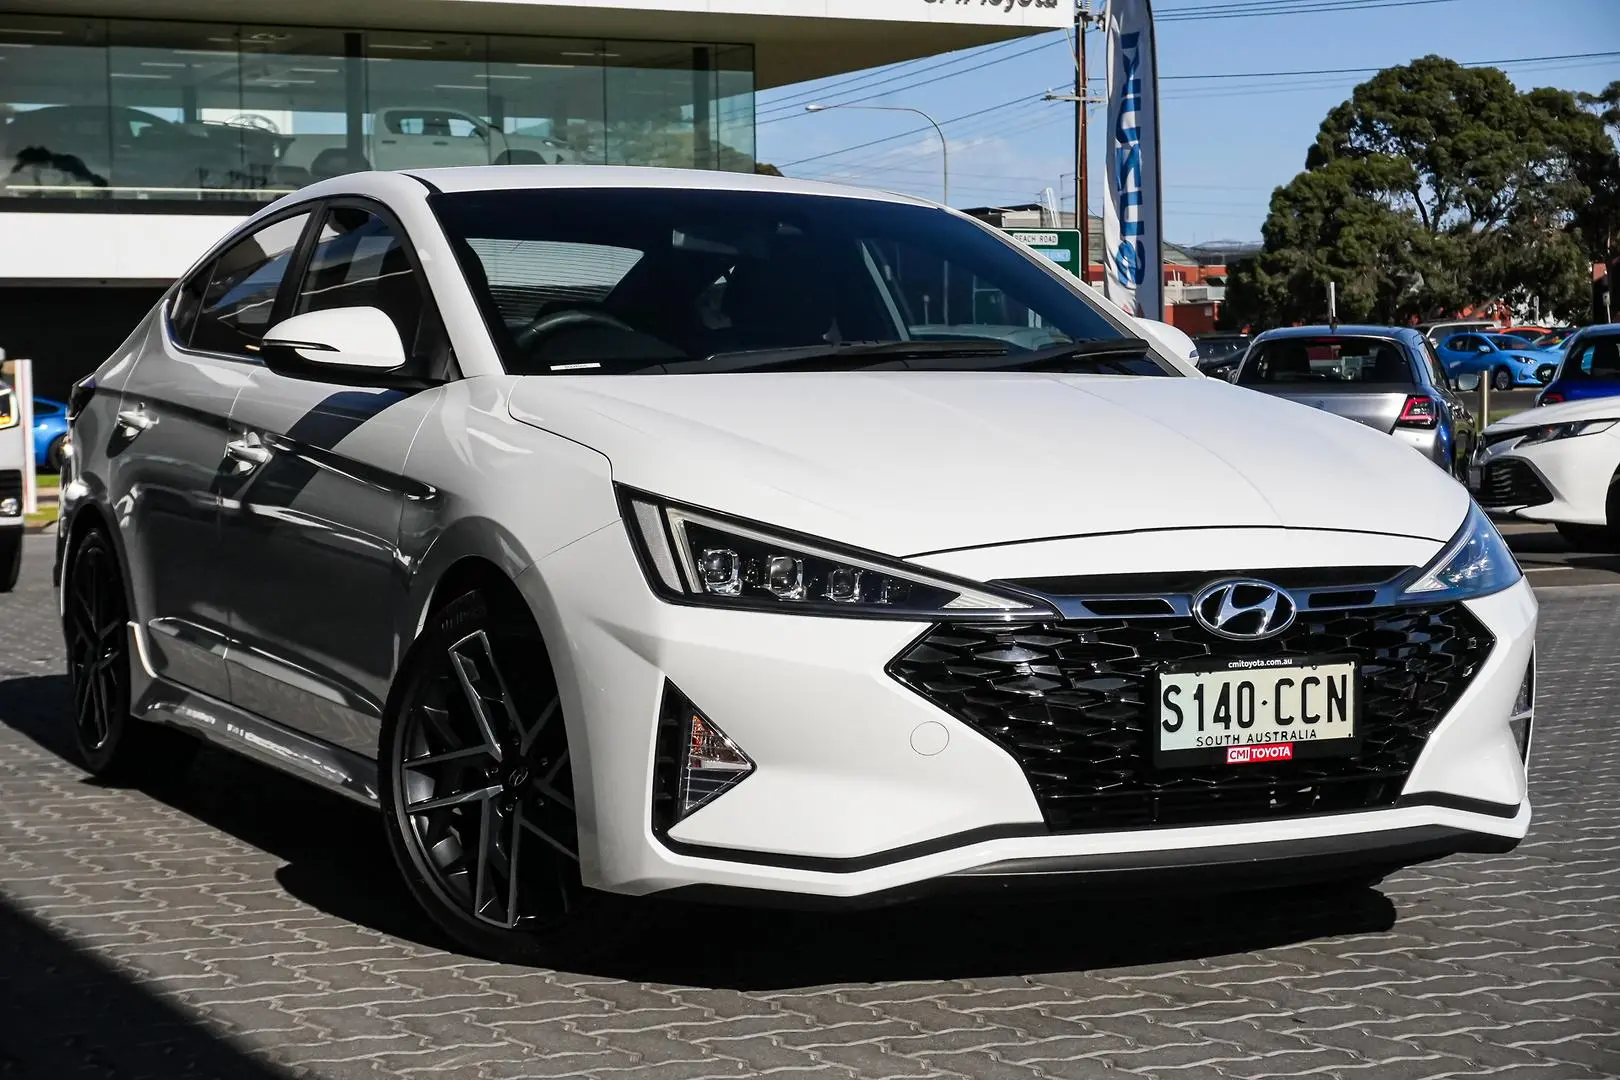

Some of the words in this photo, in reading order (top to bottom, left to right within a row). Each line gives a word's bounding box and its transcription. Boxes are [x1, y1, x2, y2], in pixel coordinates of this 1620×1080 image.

[1039, 235, 1057, 243] ROAD
[1228, 658, 1293, 669] cmitoyota.com.au
[1196, 734, 1241, 747] SOUTH
[1246, 728, 1318, 745] AUSTRALIA
[1229, 749, 1250, 761] CMI
[1252, 746, 1292, 760] TOYOTA
